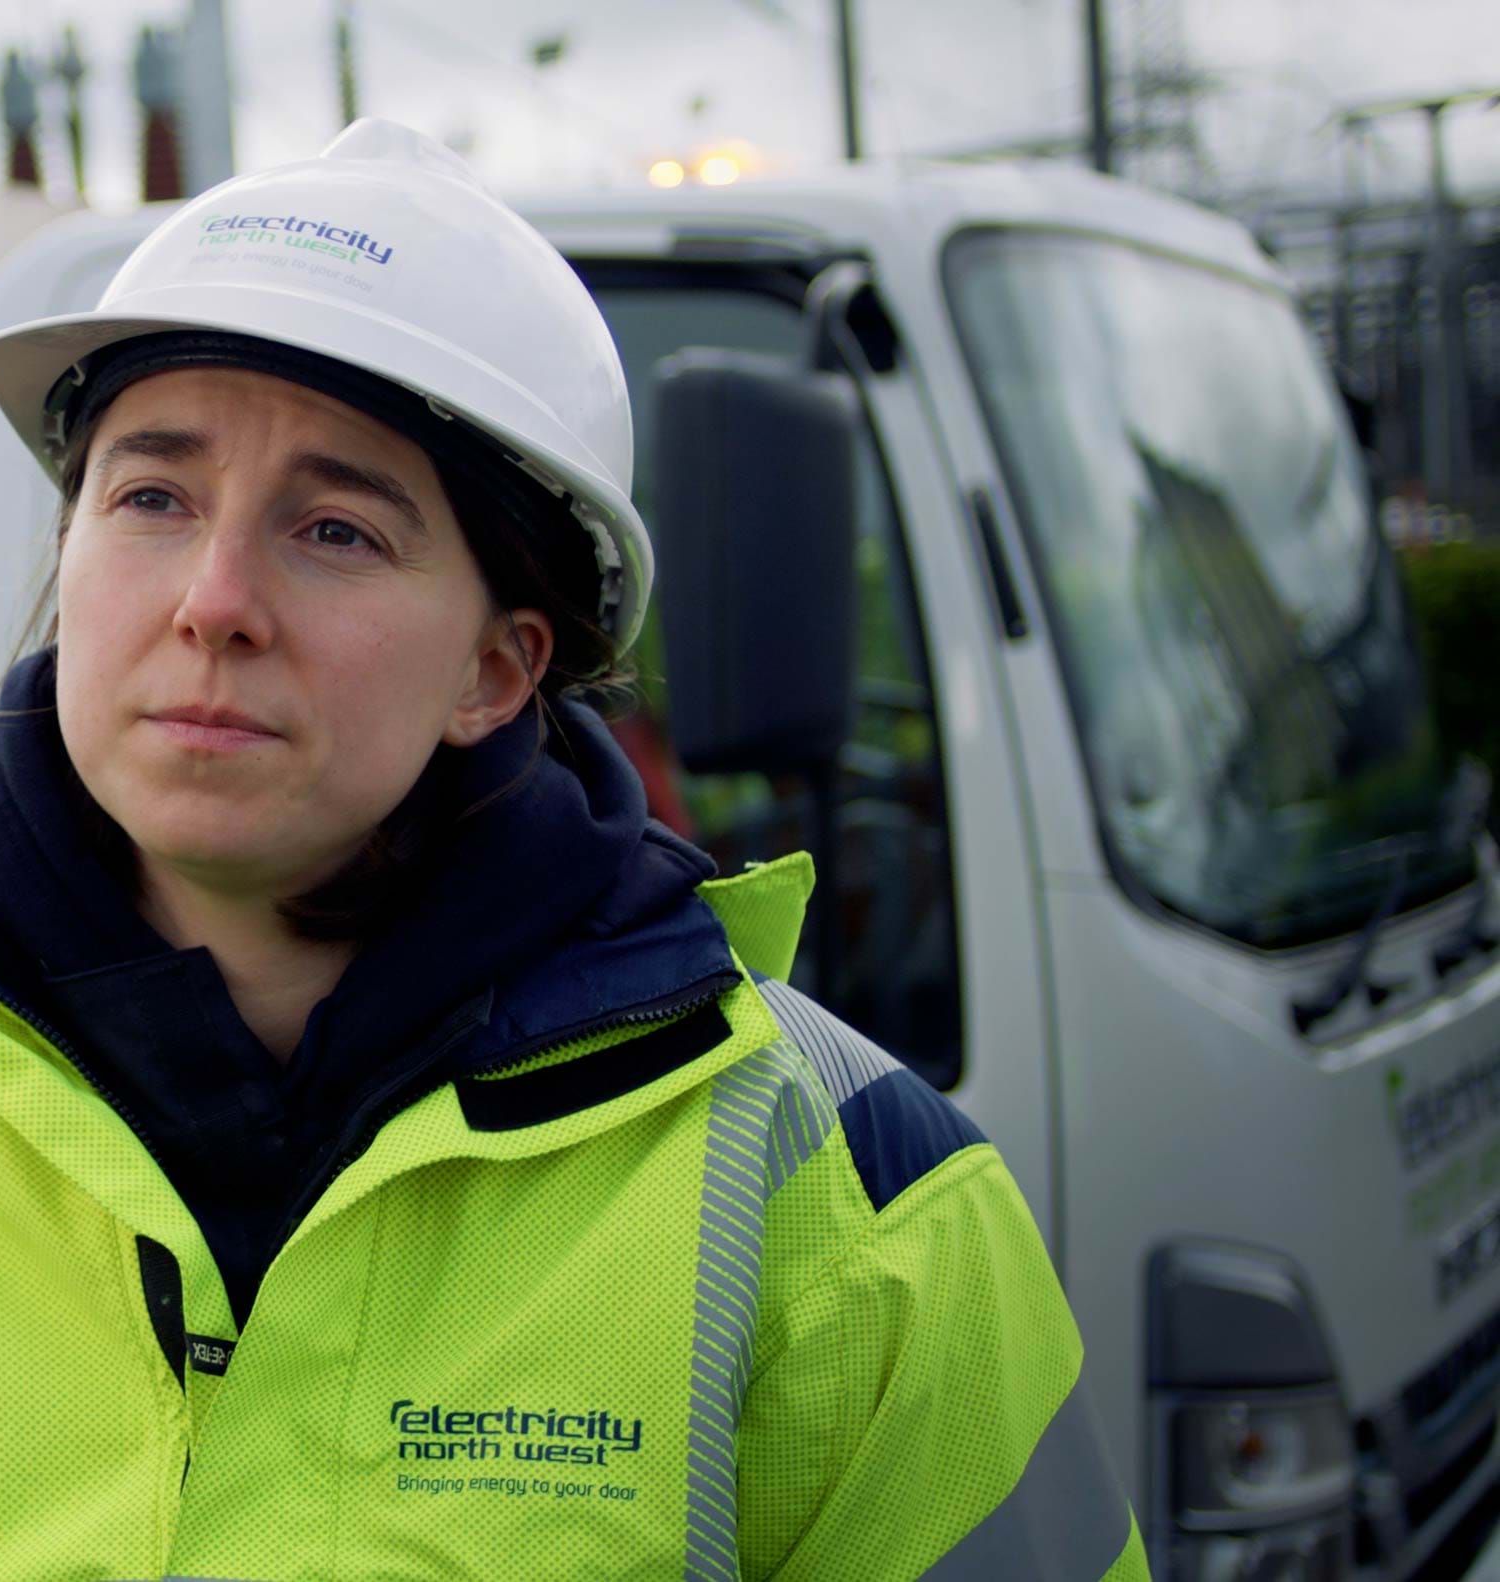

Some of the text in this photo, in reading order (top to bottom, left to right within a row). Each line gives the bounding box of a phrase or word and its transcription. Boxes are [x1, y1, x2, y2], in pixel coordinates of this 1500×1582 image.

[198, 229, 362, 265] north west
[205, 214, 394, 265] electricity
[399, 1403, 642, 1452] electricity
[399, 1437, 608, 1467] north west
[397, 1473, 638, 1501] Bringing energy to your door
